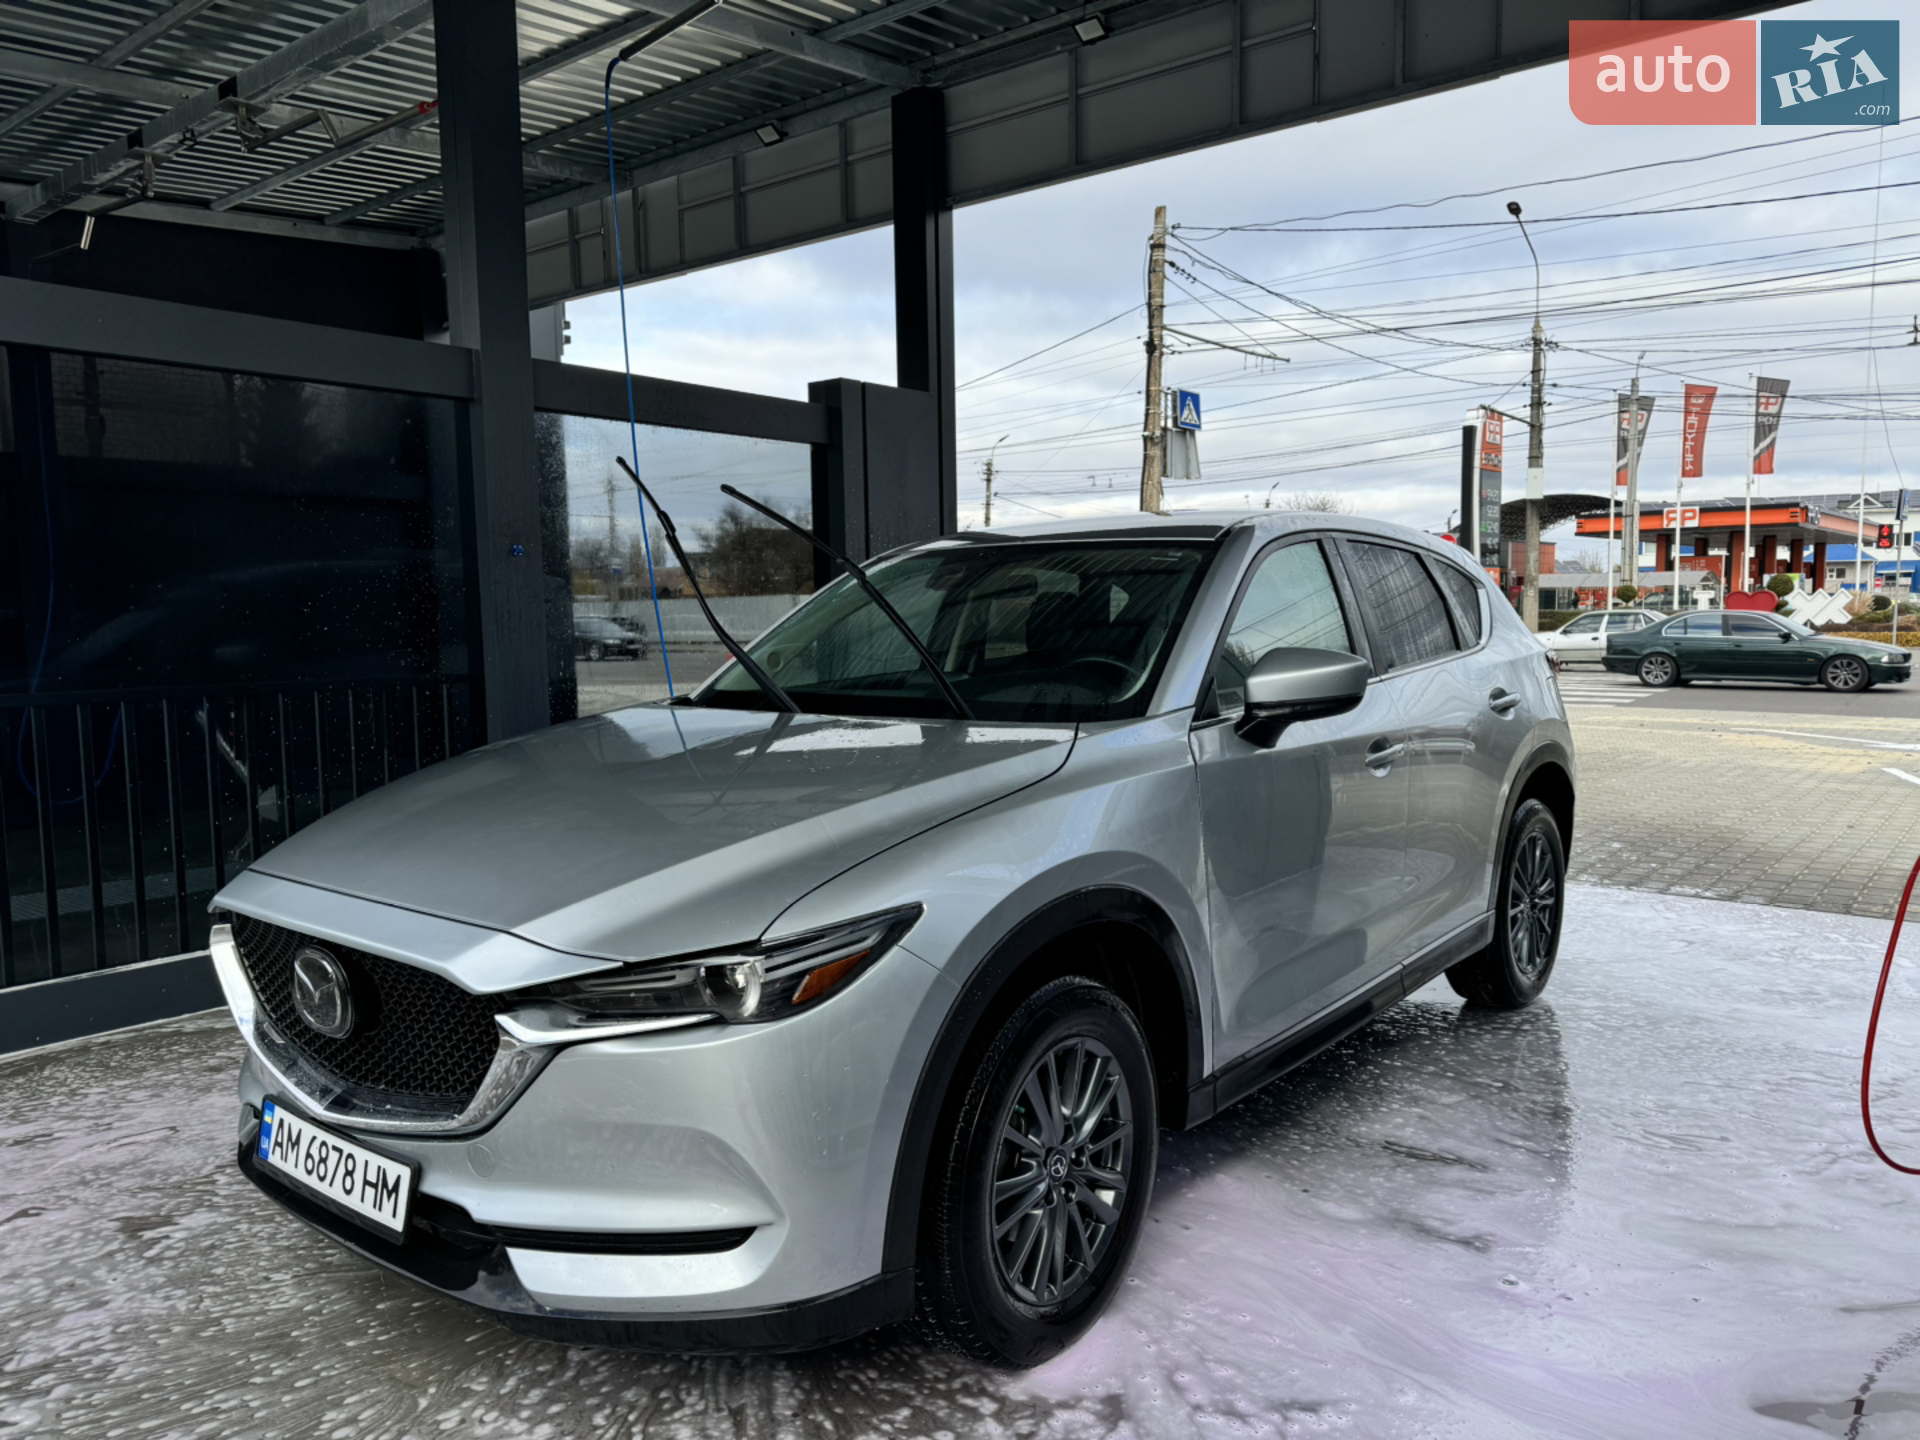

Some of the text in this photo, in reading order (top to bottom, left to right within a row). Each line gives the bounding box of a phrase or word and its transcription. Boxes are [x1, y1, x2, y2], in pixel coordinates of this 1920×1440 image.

[272, 1117, 402, 1219] AM 6878 HM
